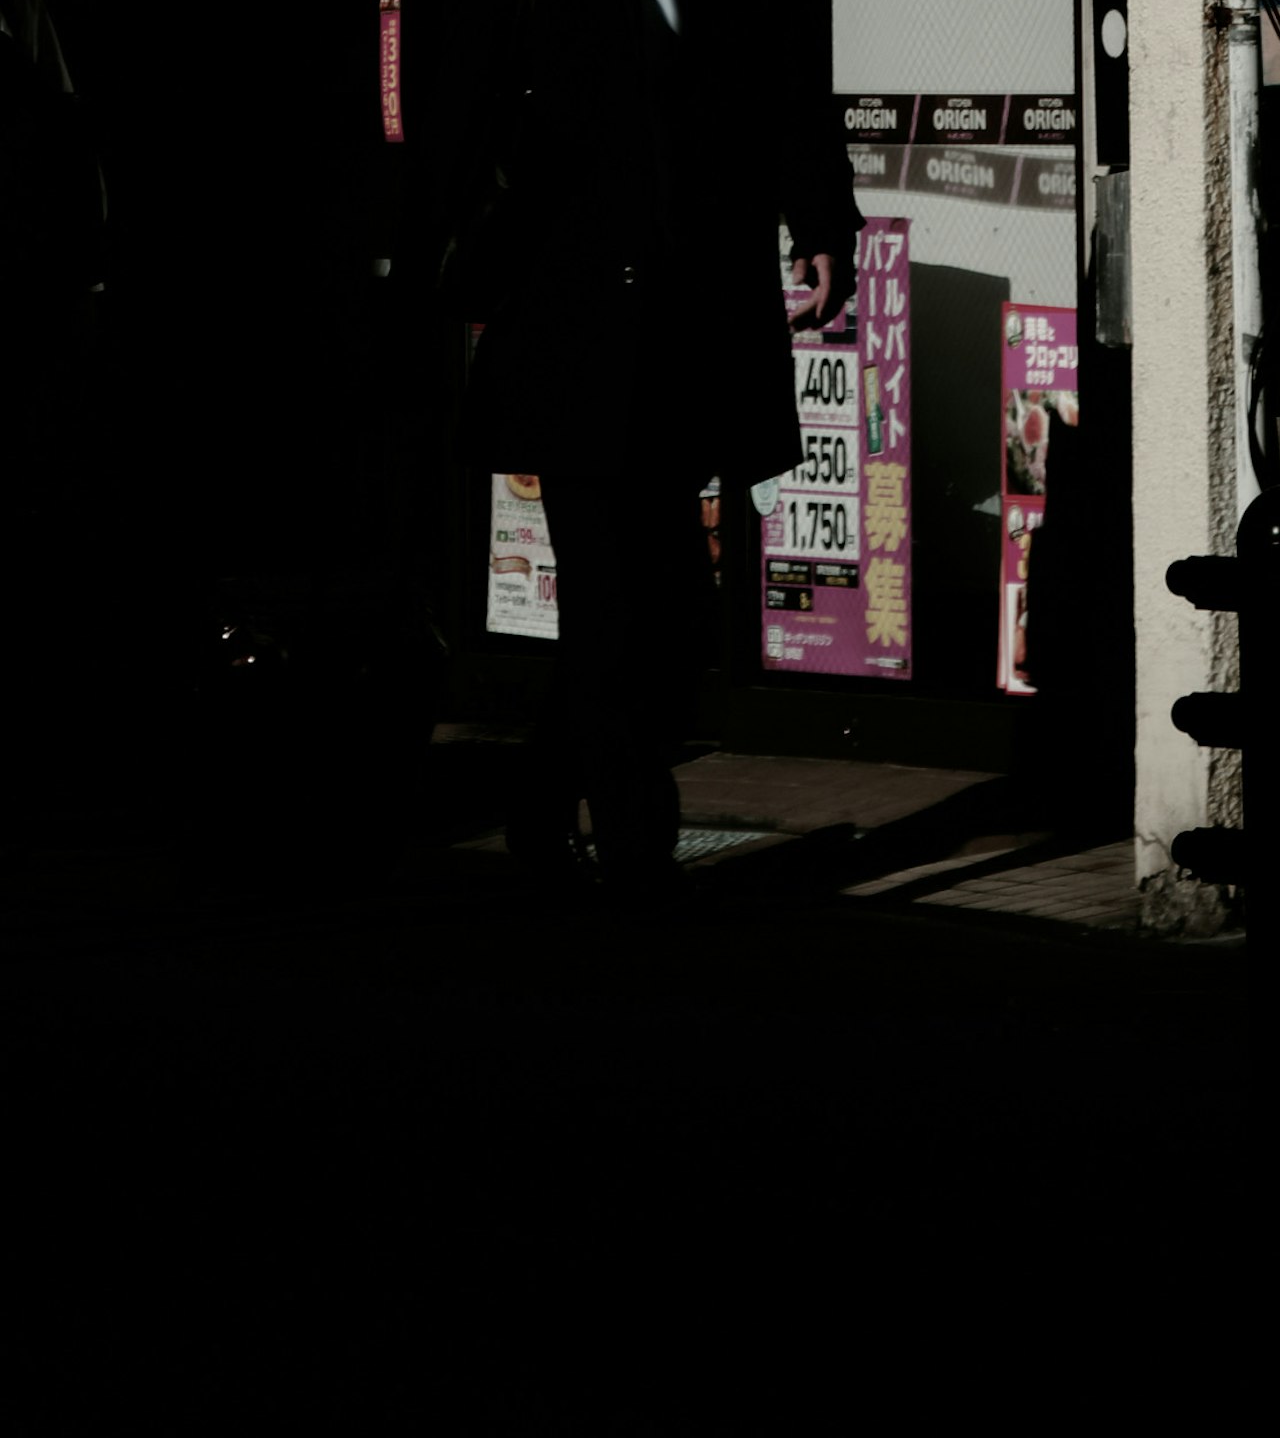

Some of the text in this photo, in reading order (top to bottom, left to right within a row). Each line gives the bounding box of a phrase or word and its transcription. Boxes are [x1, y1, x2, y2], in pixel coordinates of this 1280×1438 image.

[844, 108, 897, 130] ORIGIN
[932, 108, 988, 130] ORIGIN
[883, 232, 907, 449] アルバイト
[863, 461, 908, 647] 募集
